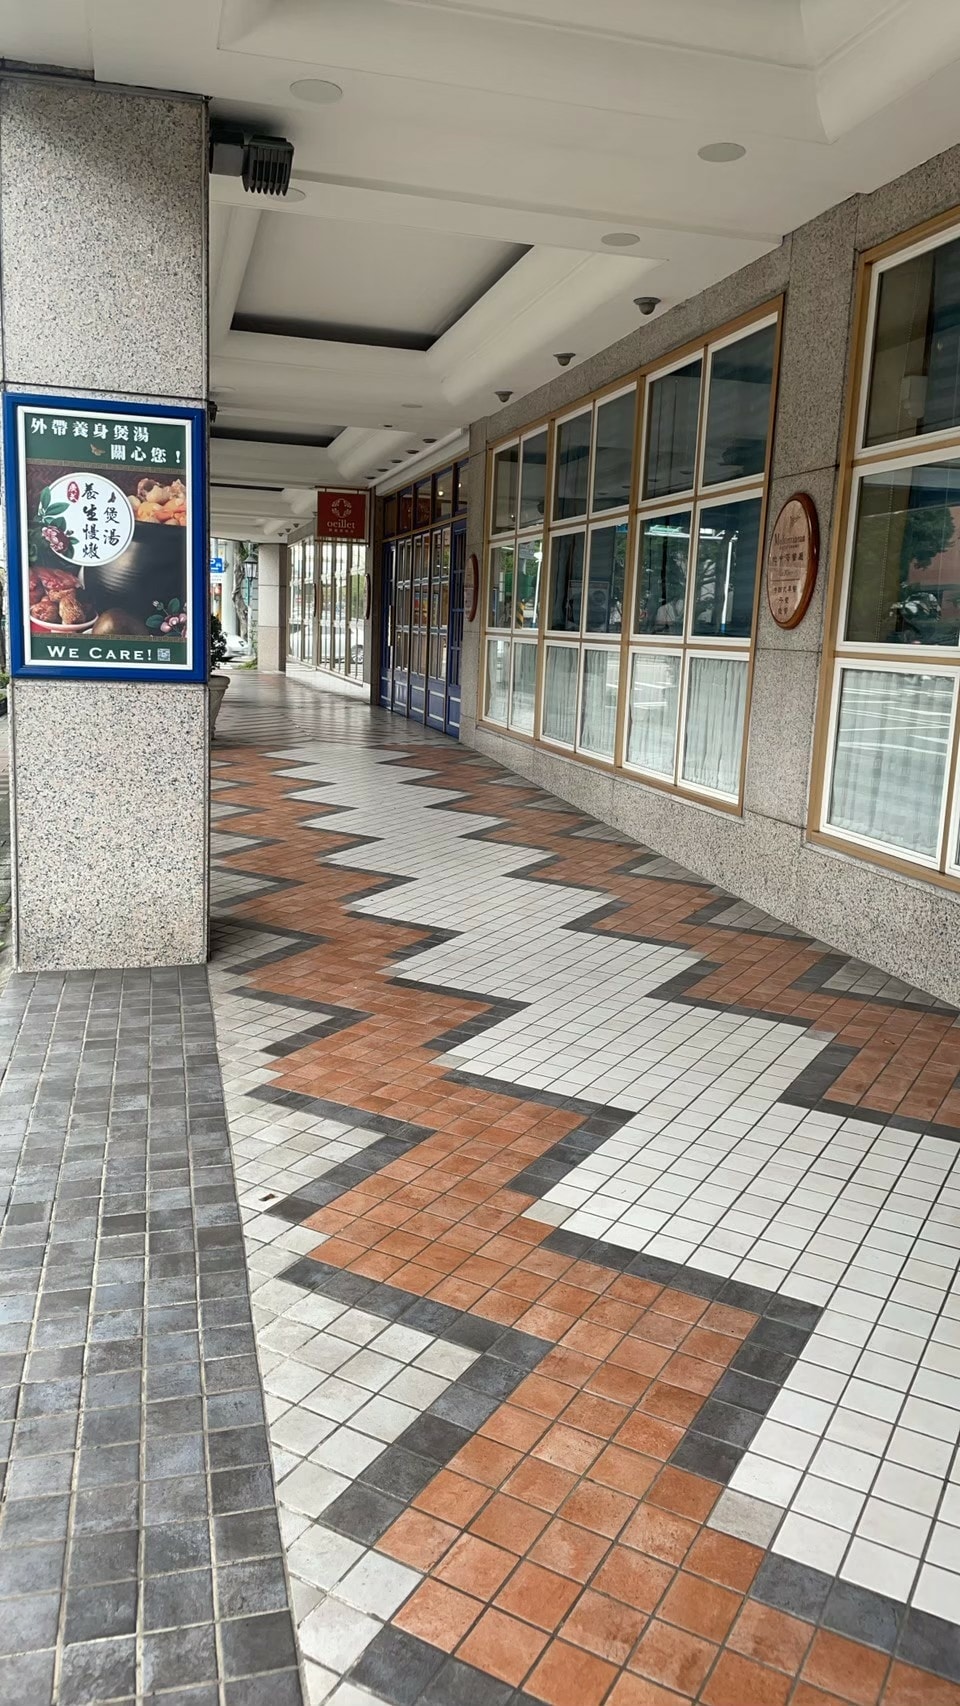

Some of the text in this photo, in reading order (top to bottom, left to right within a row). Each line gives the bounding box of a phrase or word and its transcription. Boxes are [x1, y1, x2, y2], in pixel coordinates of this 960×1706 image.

[31, 417, 149, 443] 外帶養身煲湯
[81, 482, 101, 560] 養生慢燉
[103, 506, 121, 546] 煲湯
[47, 645, 152, 661] WE CARE!
